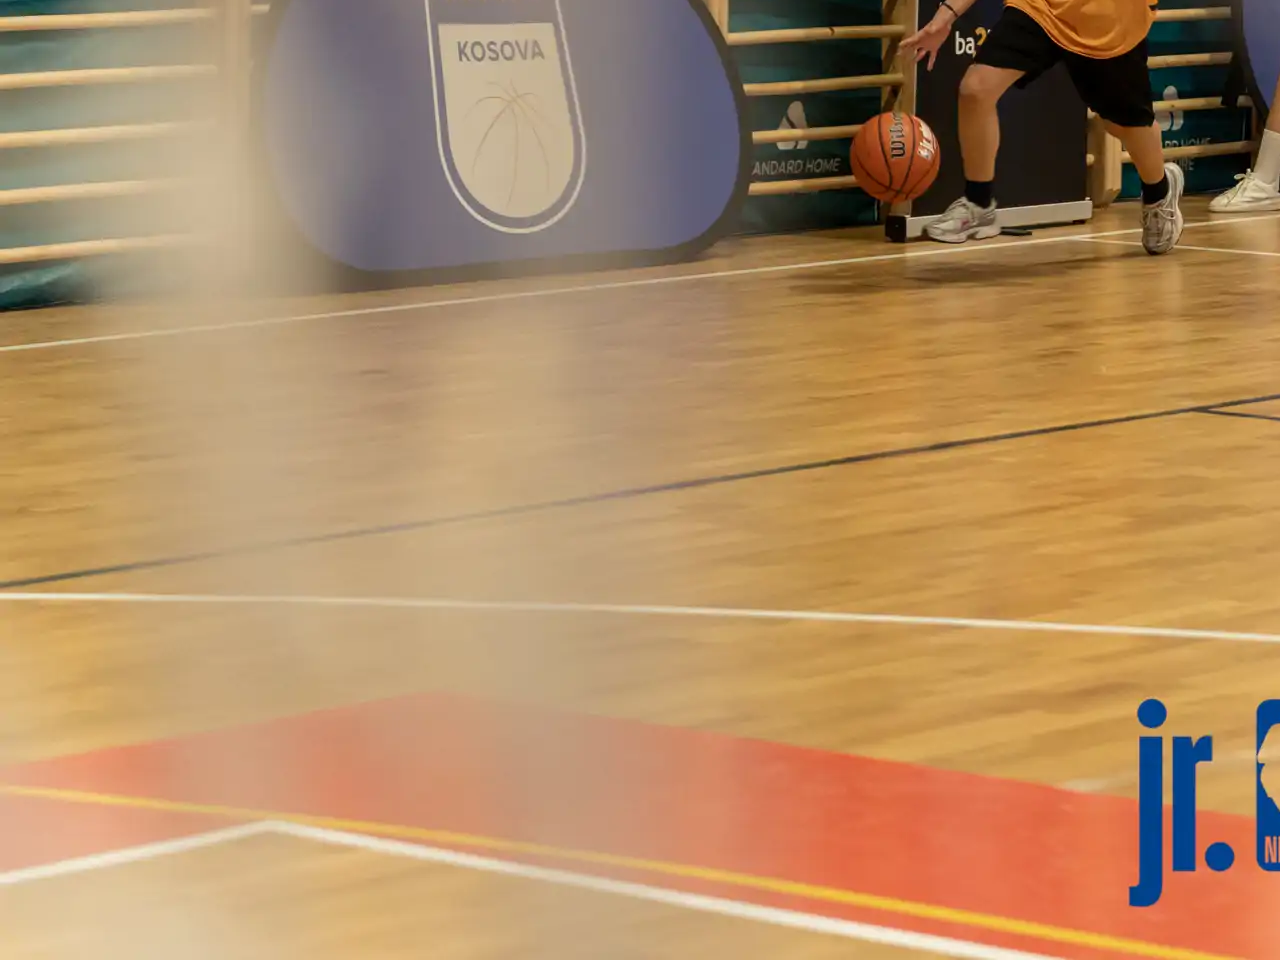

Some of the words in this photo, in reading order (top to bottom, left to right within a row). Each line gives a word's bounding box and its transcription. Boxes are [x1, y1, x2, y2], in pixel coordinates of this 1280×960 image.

[457, 39, 546, 63] KOSOVA
[752, 158, 803, 177] ANDARD
[805, 157, 842, 173] HOME
